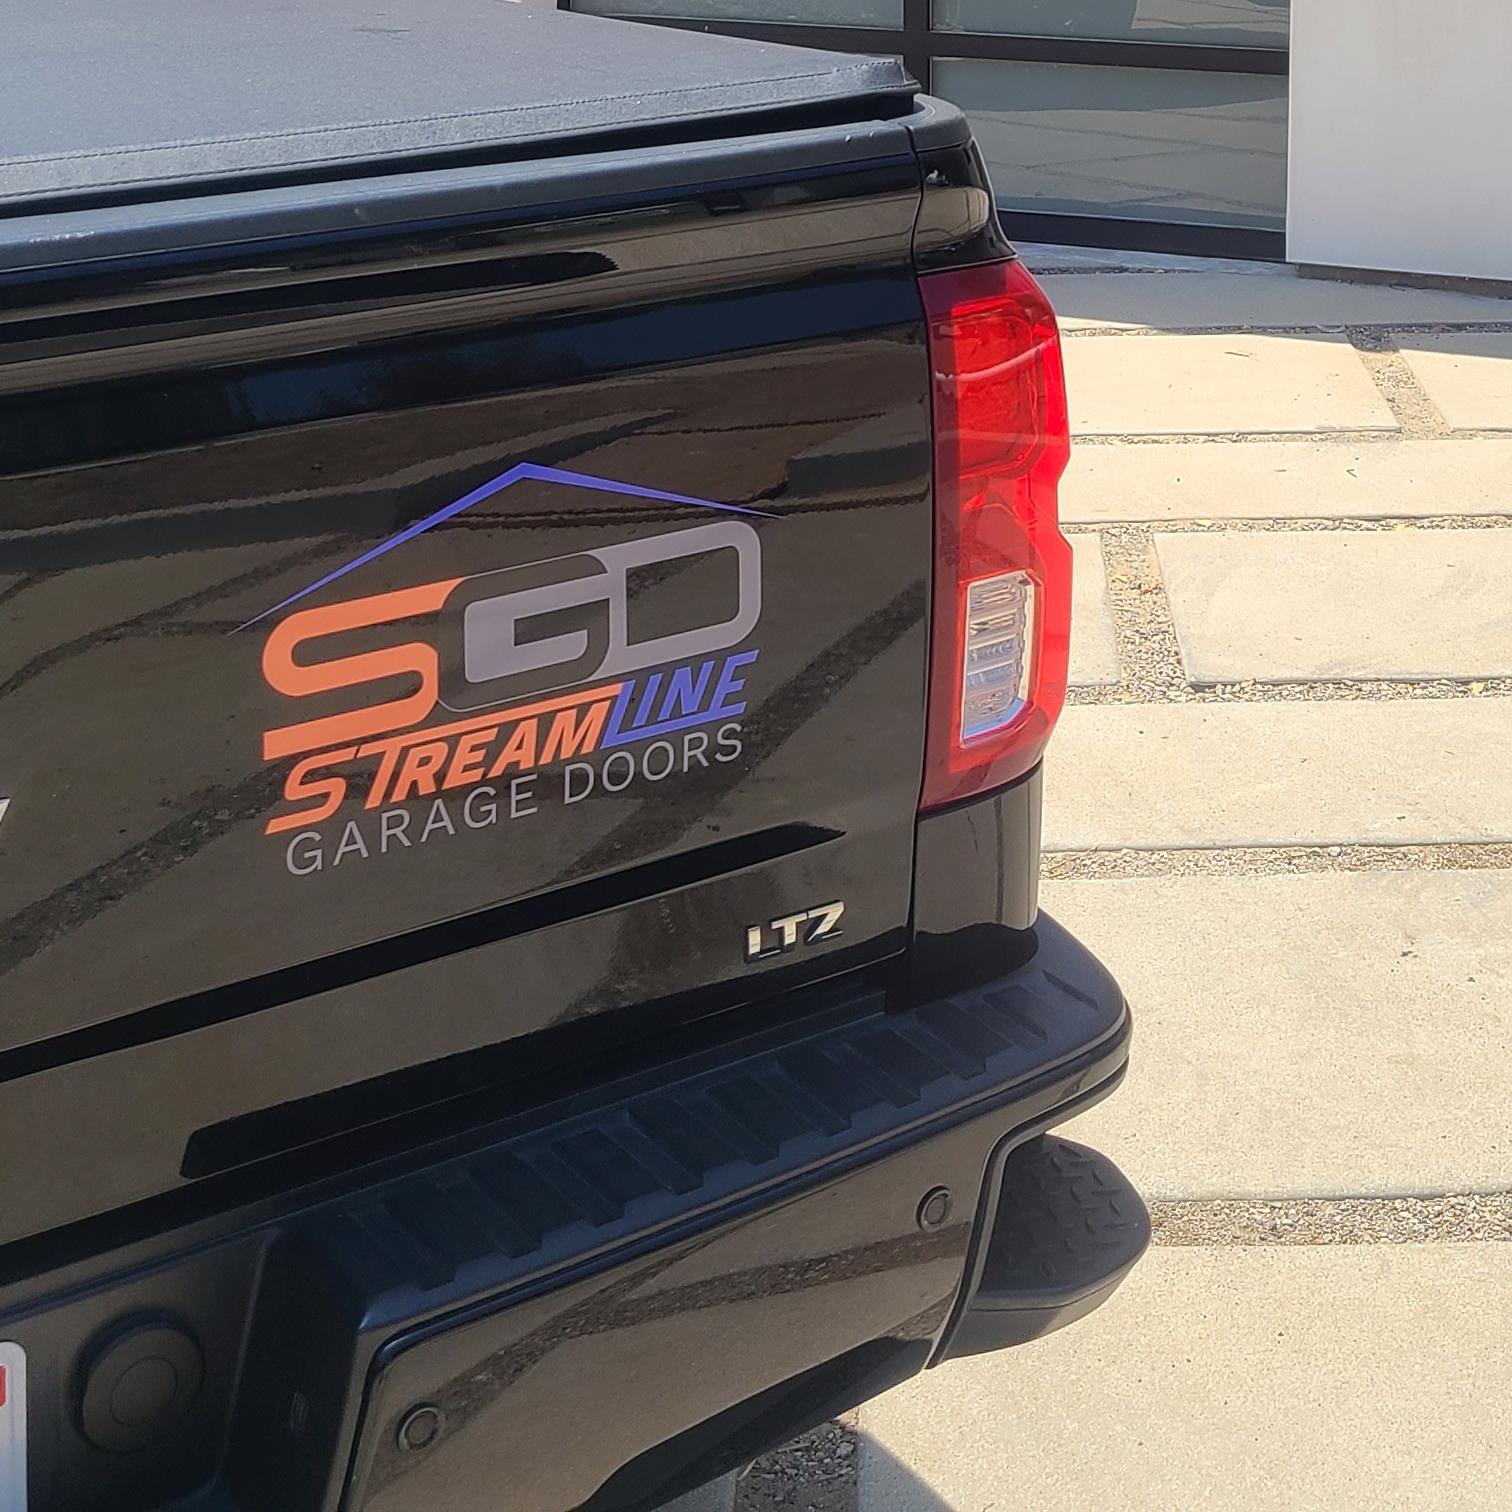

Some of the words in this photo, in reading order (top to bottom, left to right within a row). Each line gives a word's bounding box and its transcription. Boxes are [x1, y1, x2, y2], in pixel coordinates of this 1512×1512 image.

[264, 649, 760, 835] STREAMLINE
[285, 774, 538, 876] GARAGE
[563, 722, 744, 805] DOORS
[744, 899, 845, 963] LTZ
